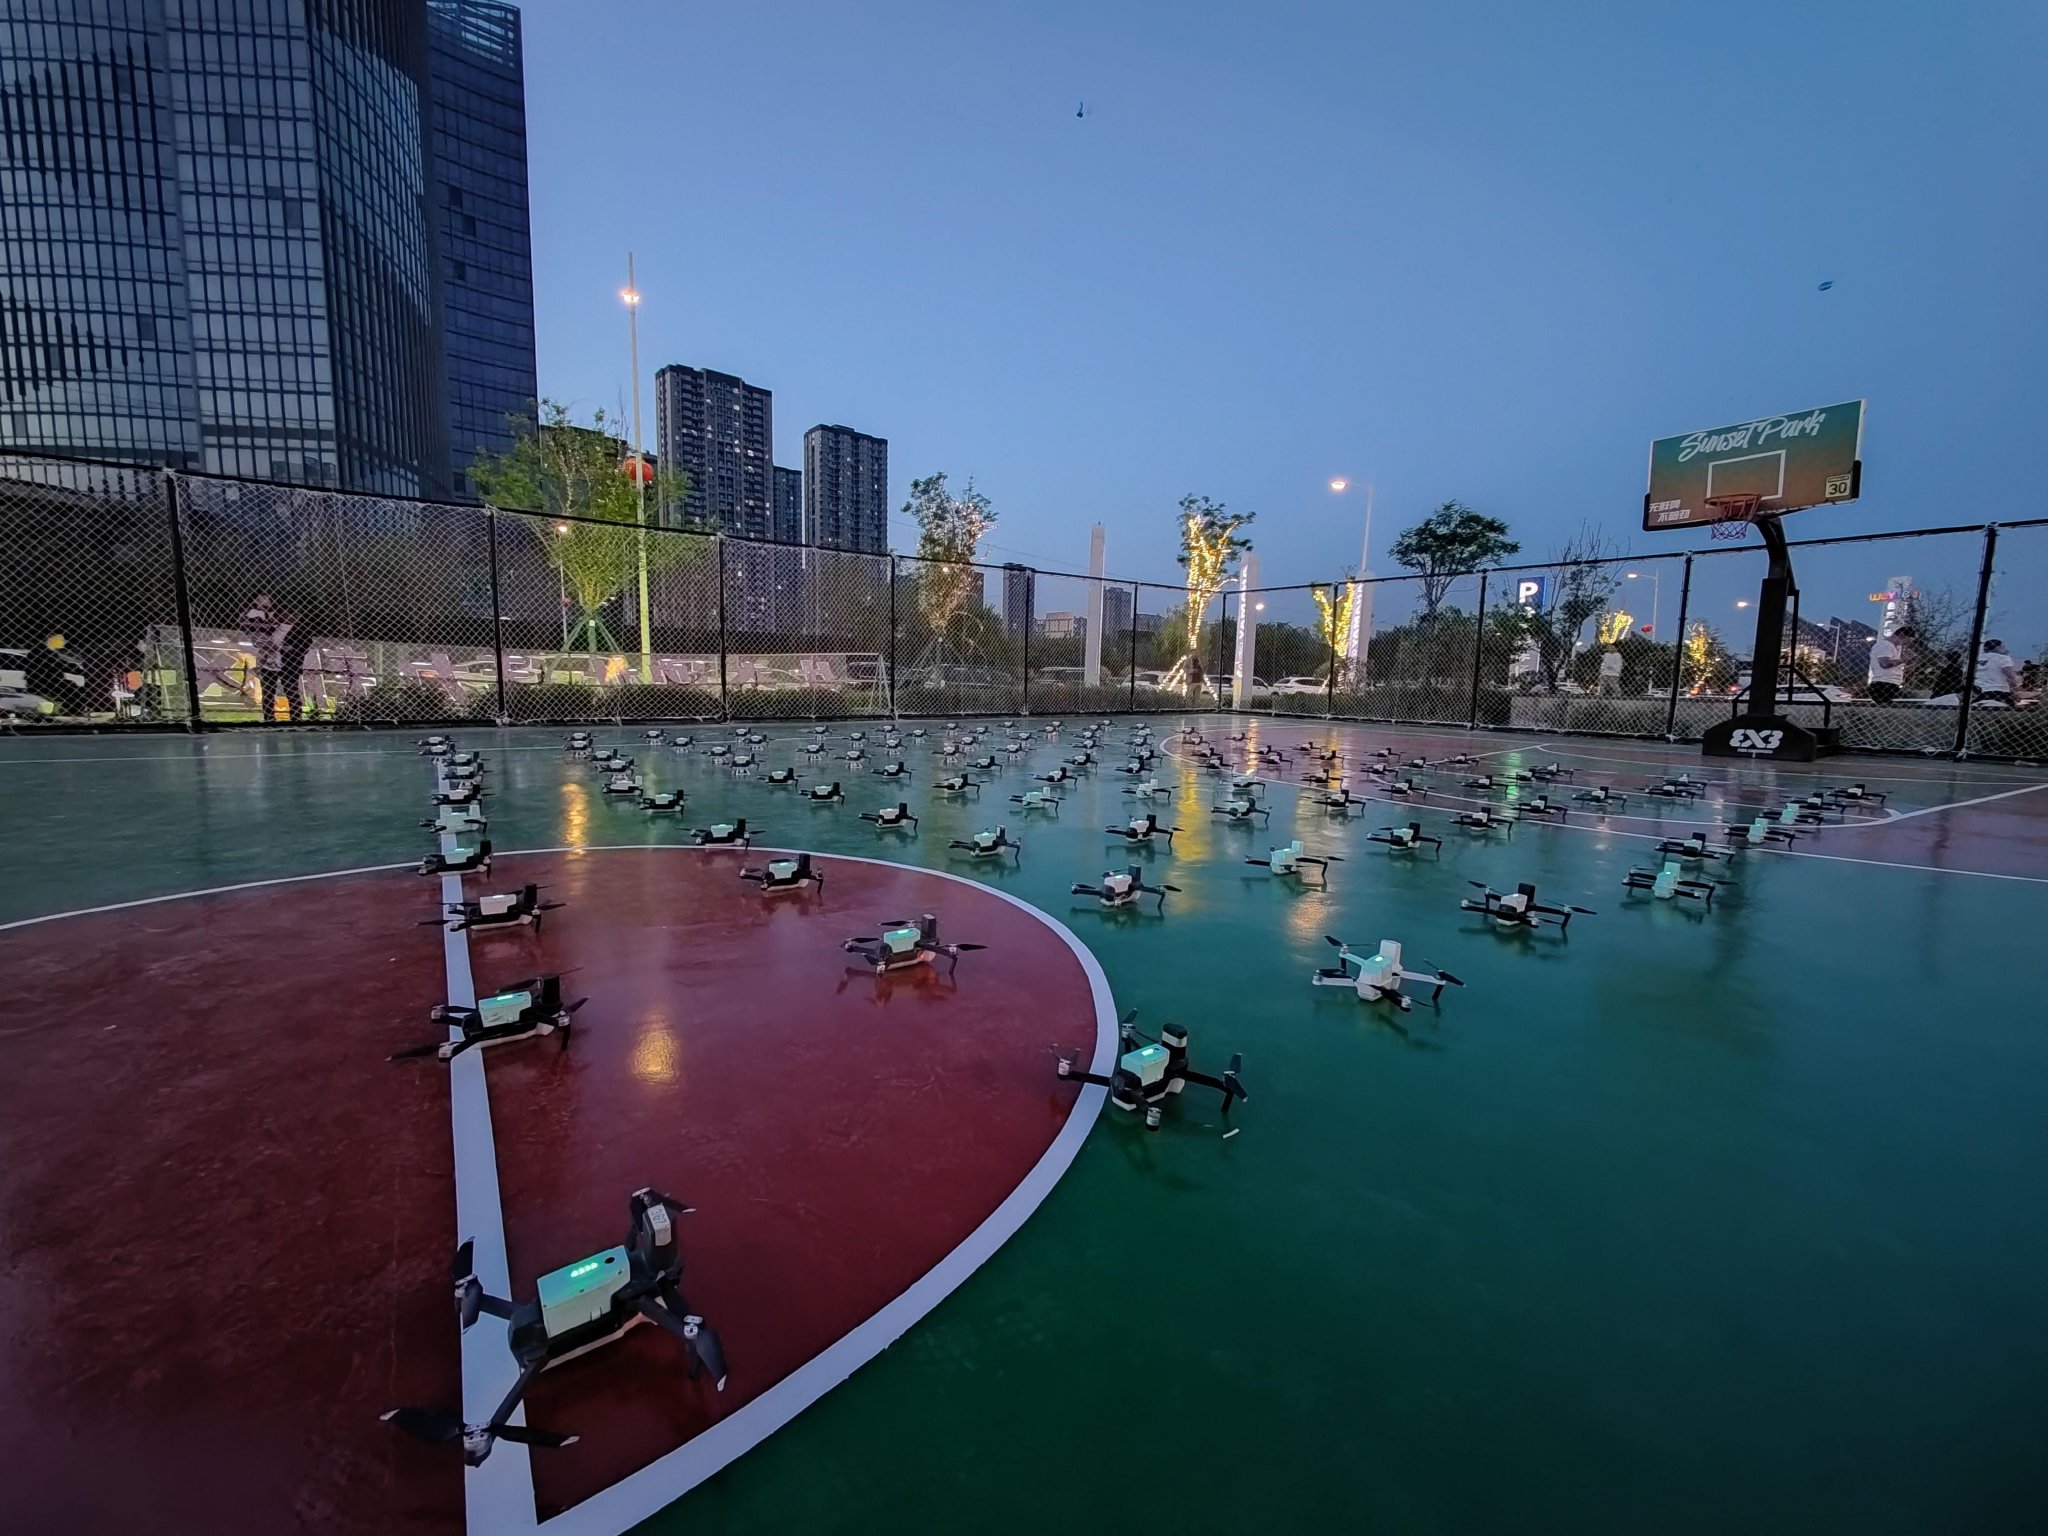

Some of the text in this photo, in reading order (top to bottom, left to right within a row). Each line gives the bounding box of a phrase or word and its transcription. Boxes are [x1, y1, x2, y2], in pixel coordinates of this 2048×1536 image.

[1677, 410, 1826, 462] Sunset Park
[1828, 481, 1848, 495] 30
[1518, 582, 1539, 604] P
